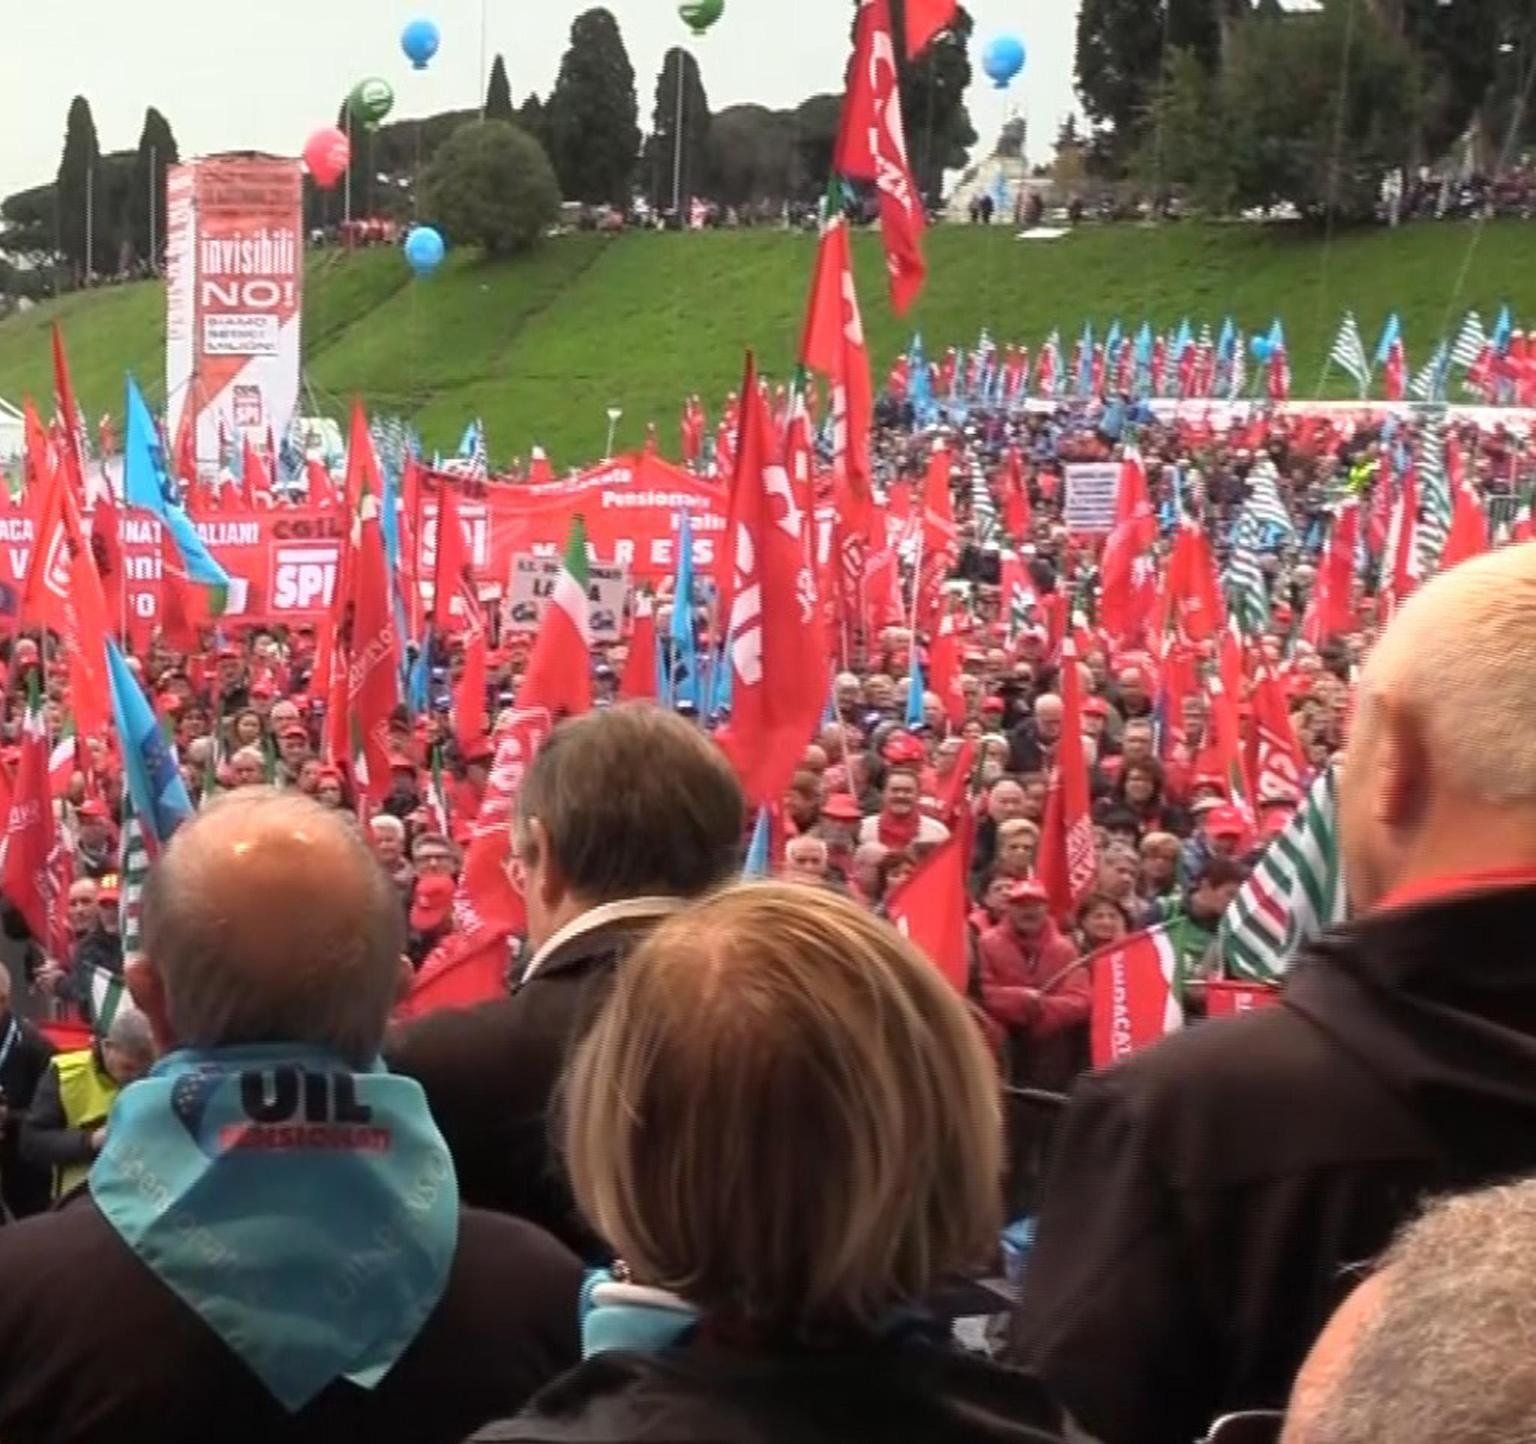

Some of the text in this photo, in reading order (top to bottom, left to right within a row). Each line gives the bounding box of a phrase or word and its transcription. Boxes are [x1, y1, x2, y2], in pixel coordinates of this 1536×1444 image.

[201, 229, 294, 274] invisibili
[202, 280, 294, 308] NO!
[274, 563, 336, 608] SPI
[240, 1064, 373, 1124] UIL
